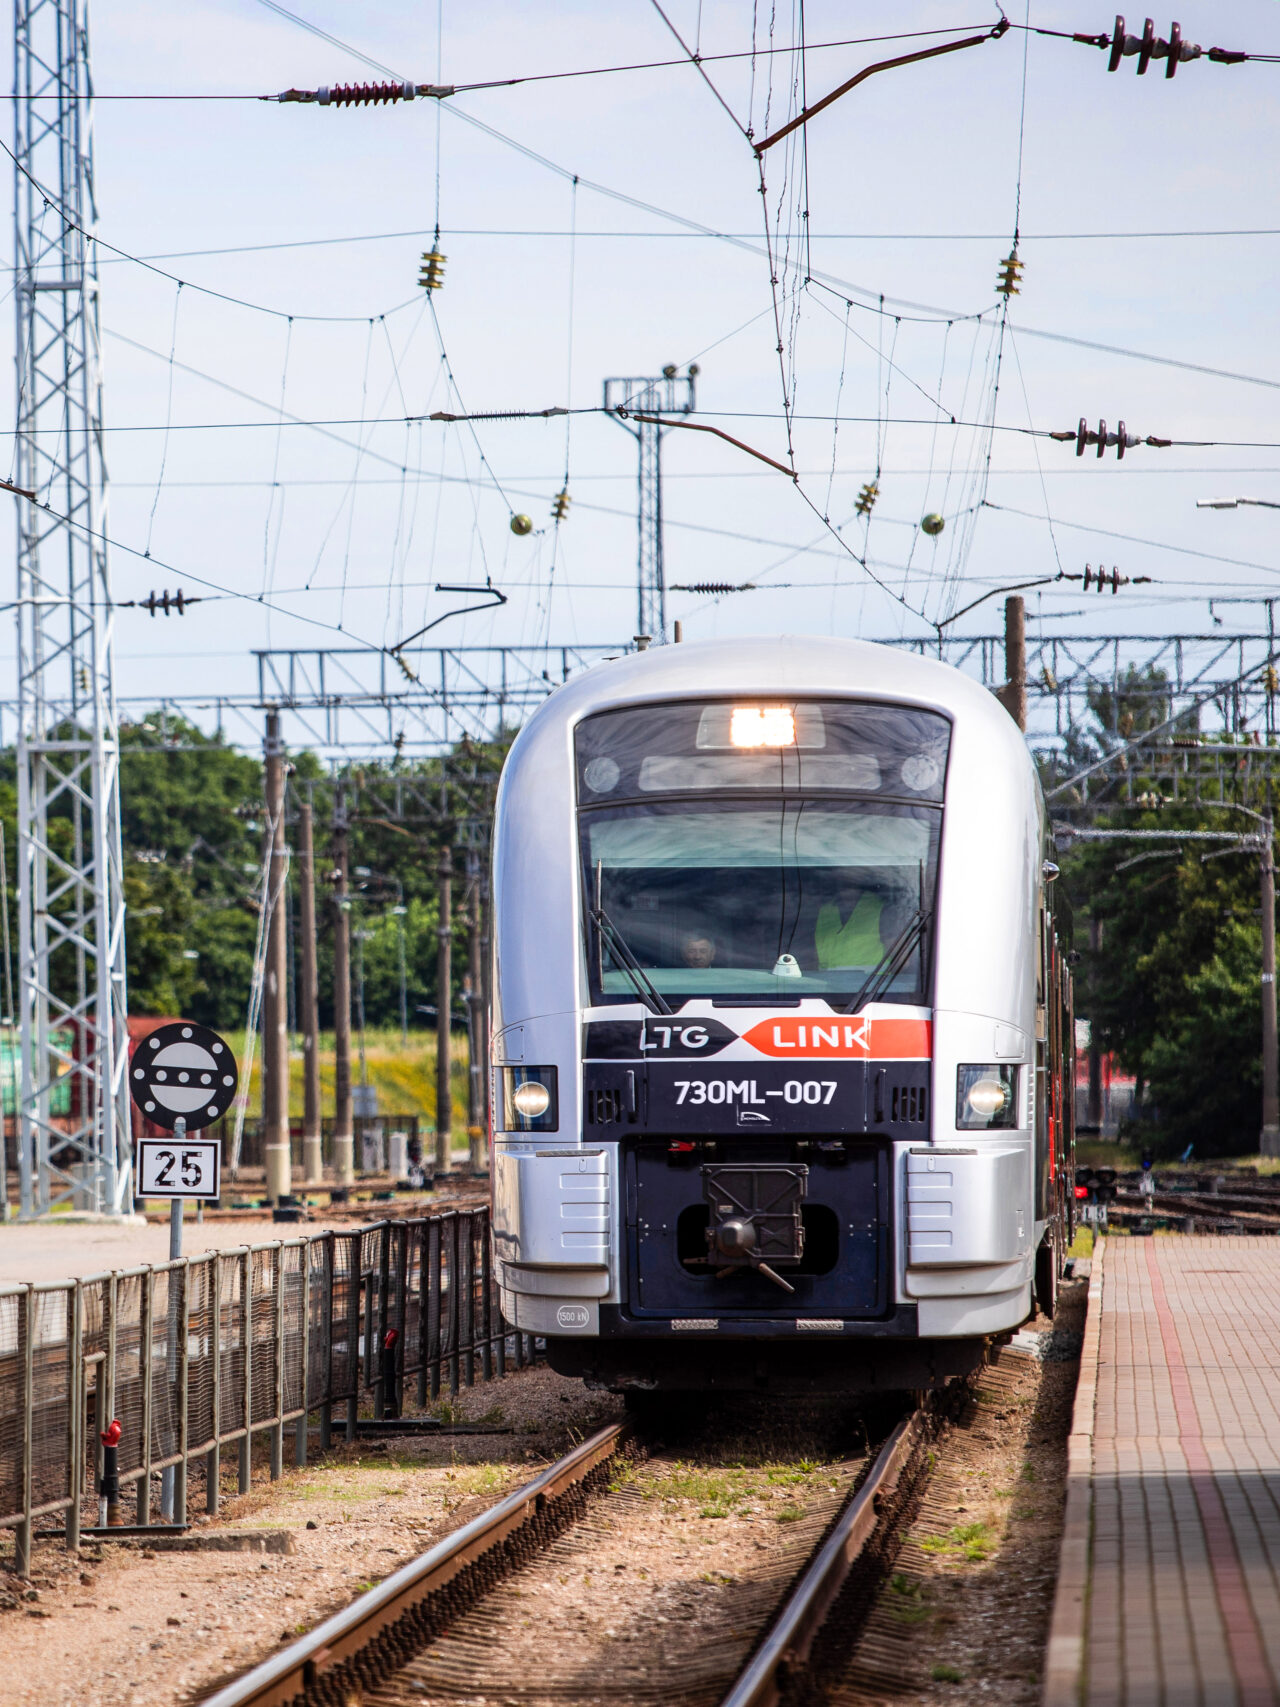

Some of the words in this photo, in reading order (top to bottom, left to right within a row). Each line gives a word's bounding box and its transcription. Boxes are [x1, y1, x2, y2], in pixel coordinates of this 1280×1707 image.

[639, 1025, 710, 1051] LTG
[773, 1025, 871, 1051] LINK
[673, 1079, 838, 1105] 730ML-007
[154, 1151, 203, 1188] 25
[577, 1312, 588, 1322] kN
